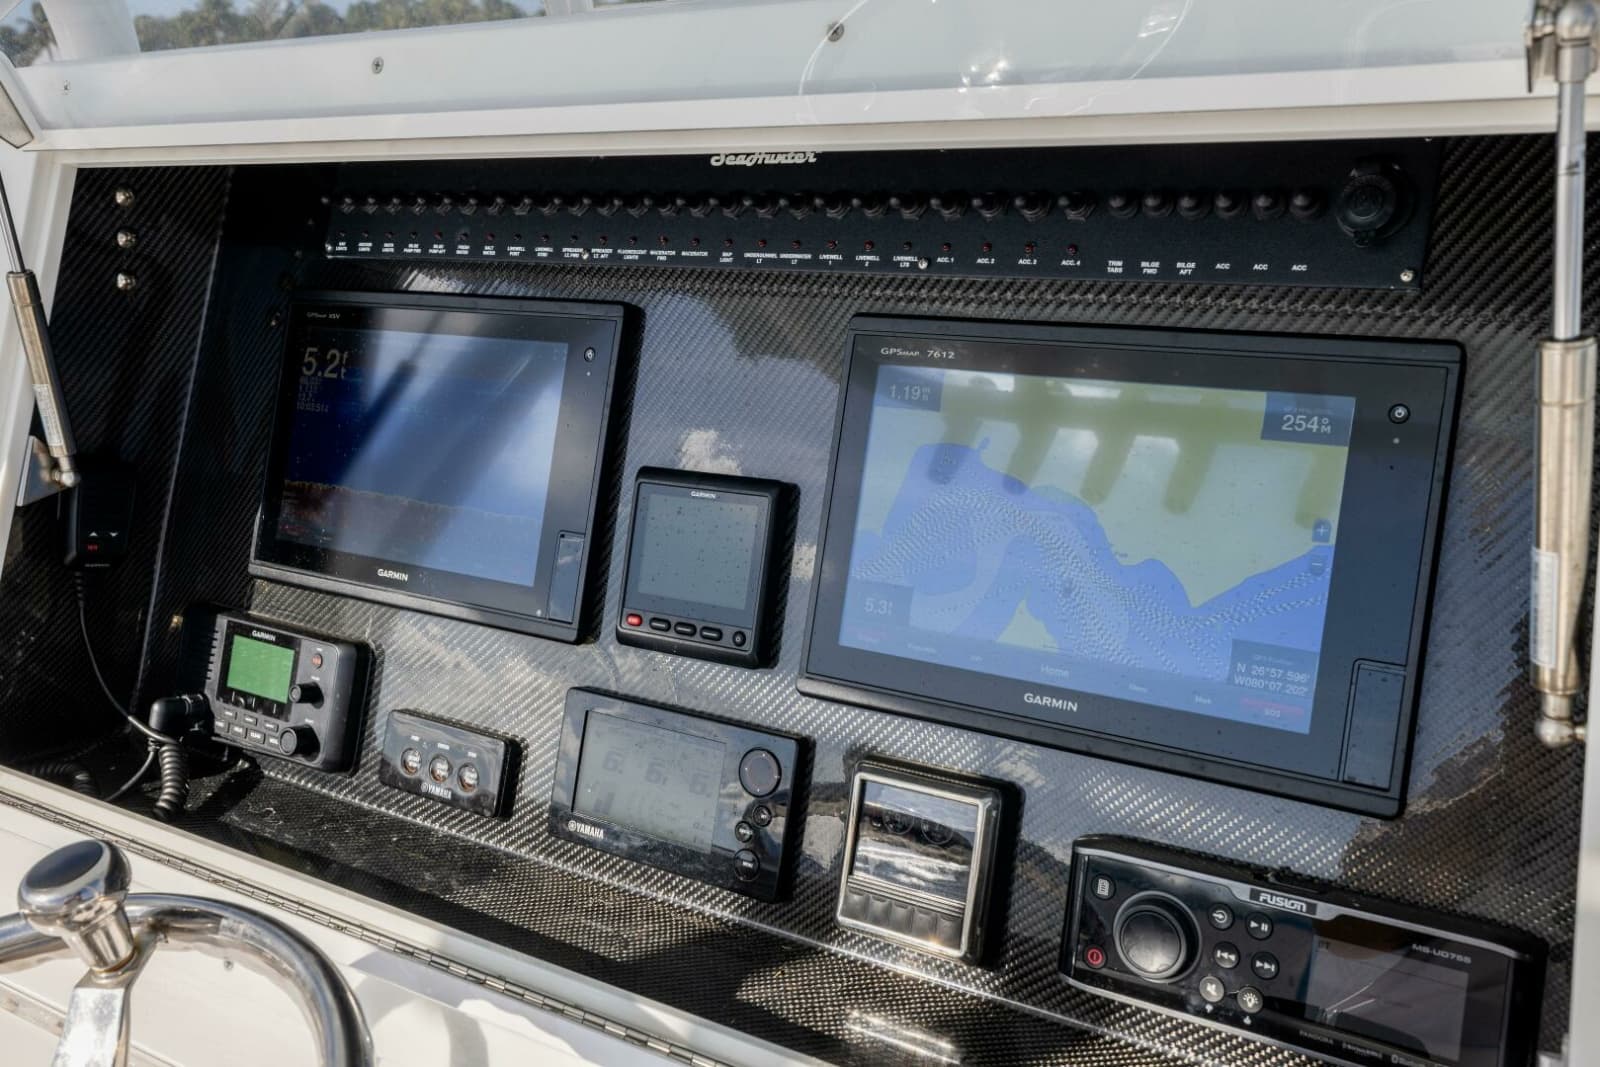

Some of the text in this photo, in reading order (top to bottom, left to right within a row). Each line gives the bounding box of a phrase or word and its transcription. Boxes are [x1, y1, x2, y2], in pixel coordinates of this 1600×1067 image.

[1215, 262, 1231, 270] ACC
[1253, 263, 1269, 271] ACC
[1291, 264, 1307, 272] ACC
[927, 349, 956, 360] 7612
[377, 568, 409, 582] GARMIN
[252, 630, 276, 642] GARMIN
[1023, 692, 1078, 714] GARMIN
[428, 783, 452, 800] YAMAHA
[576, 822, 604, 840] YAMAHA
[1259, 892, 1308, 913] FUSION
